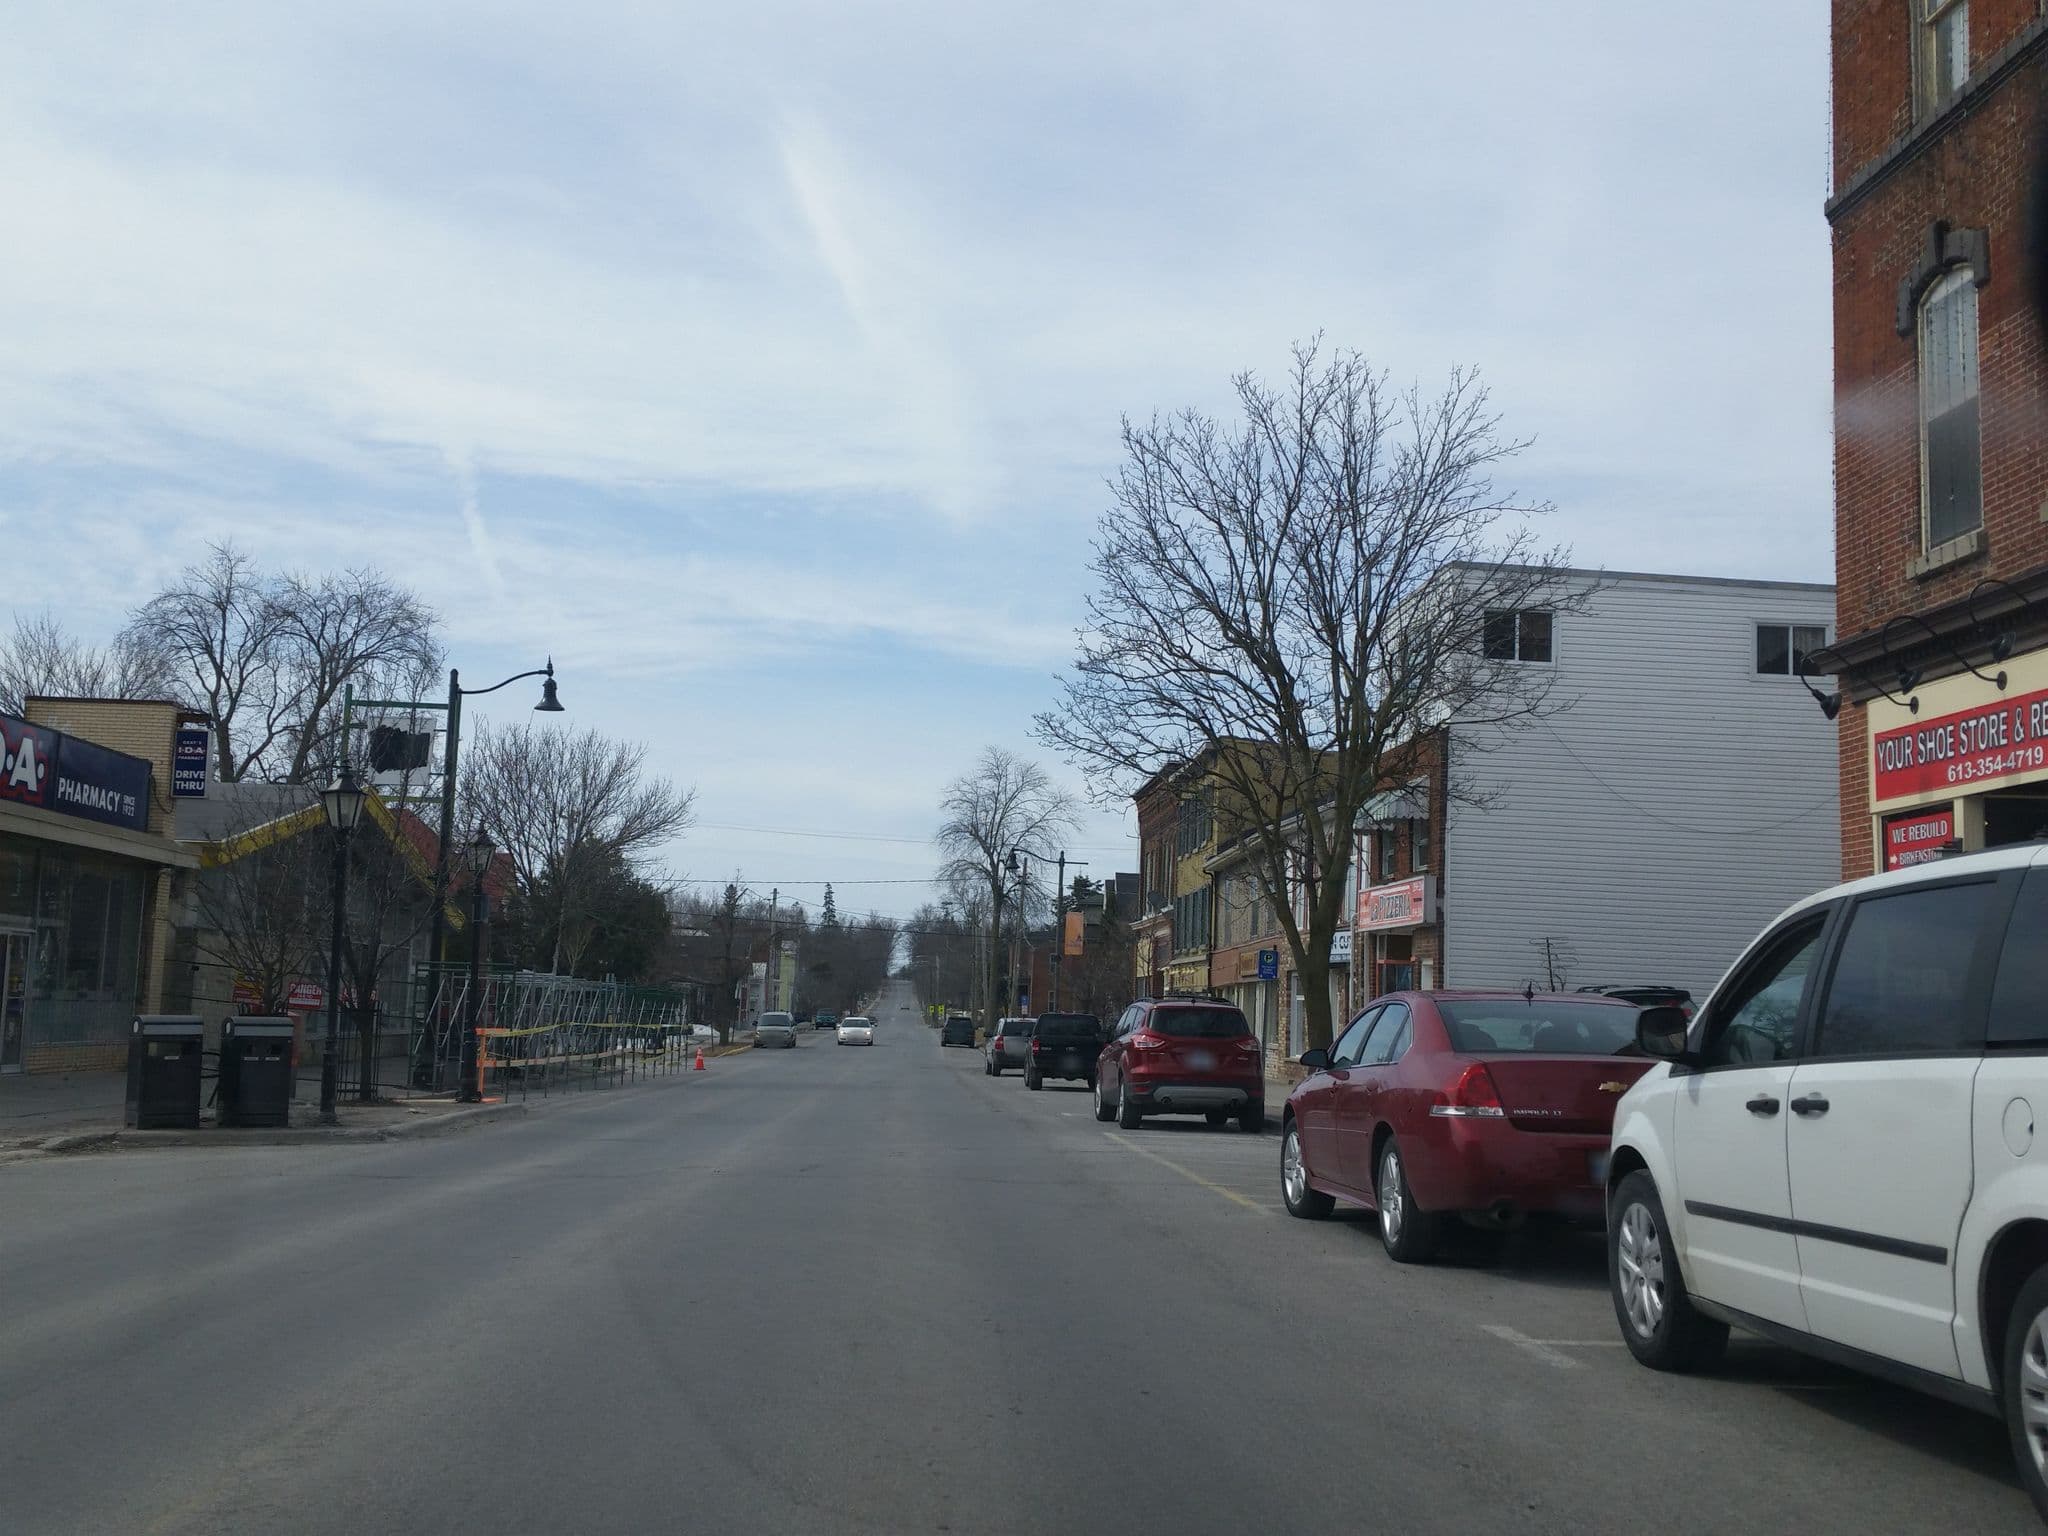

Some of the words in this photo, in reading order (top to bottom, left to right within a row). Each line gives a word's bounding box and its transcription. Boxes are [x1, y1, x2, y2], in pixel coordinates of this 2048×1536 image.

[1877, 735, 1914, 773] YOUR
[1917, 725, 1955, 764] SHOE
[1959, 711, 2008, 755] STORE
[2014, 707, 2025, 743] &
[175, 770, 206, 779] DRIVE
[1947, 746, 2044, 782] 613-354-4719
[58, 777, 121, 813] PHARMACY
[175, 780, 205, 790] THRU
[1892, 828, 1907, 844] WE
[1908, 820, 1948, 841] REBUILD
